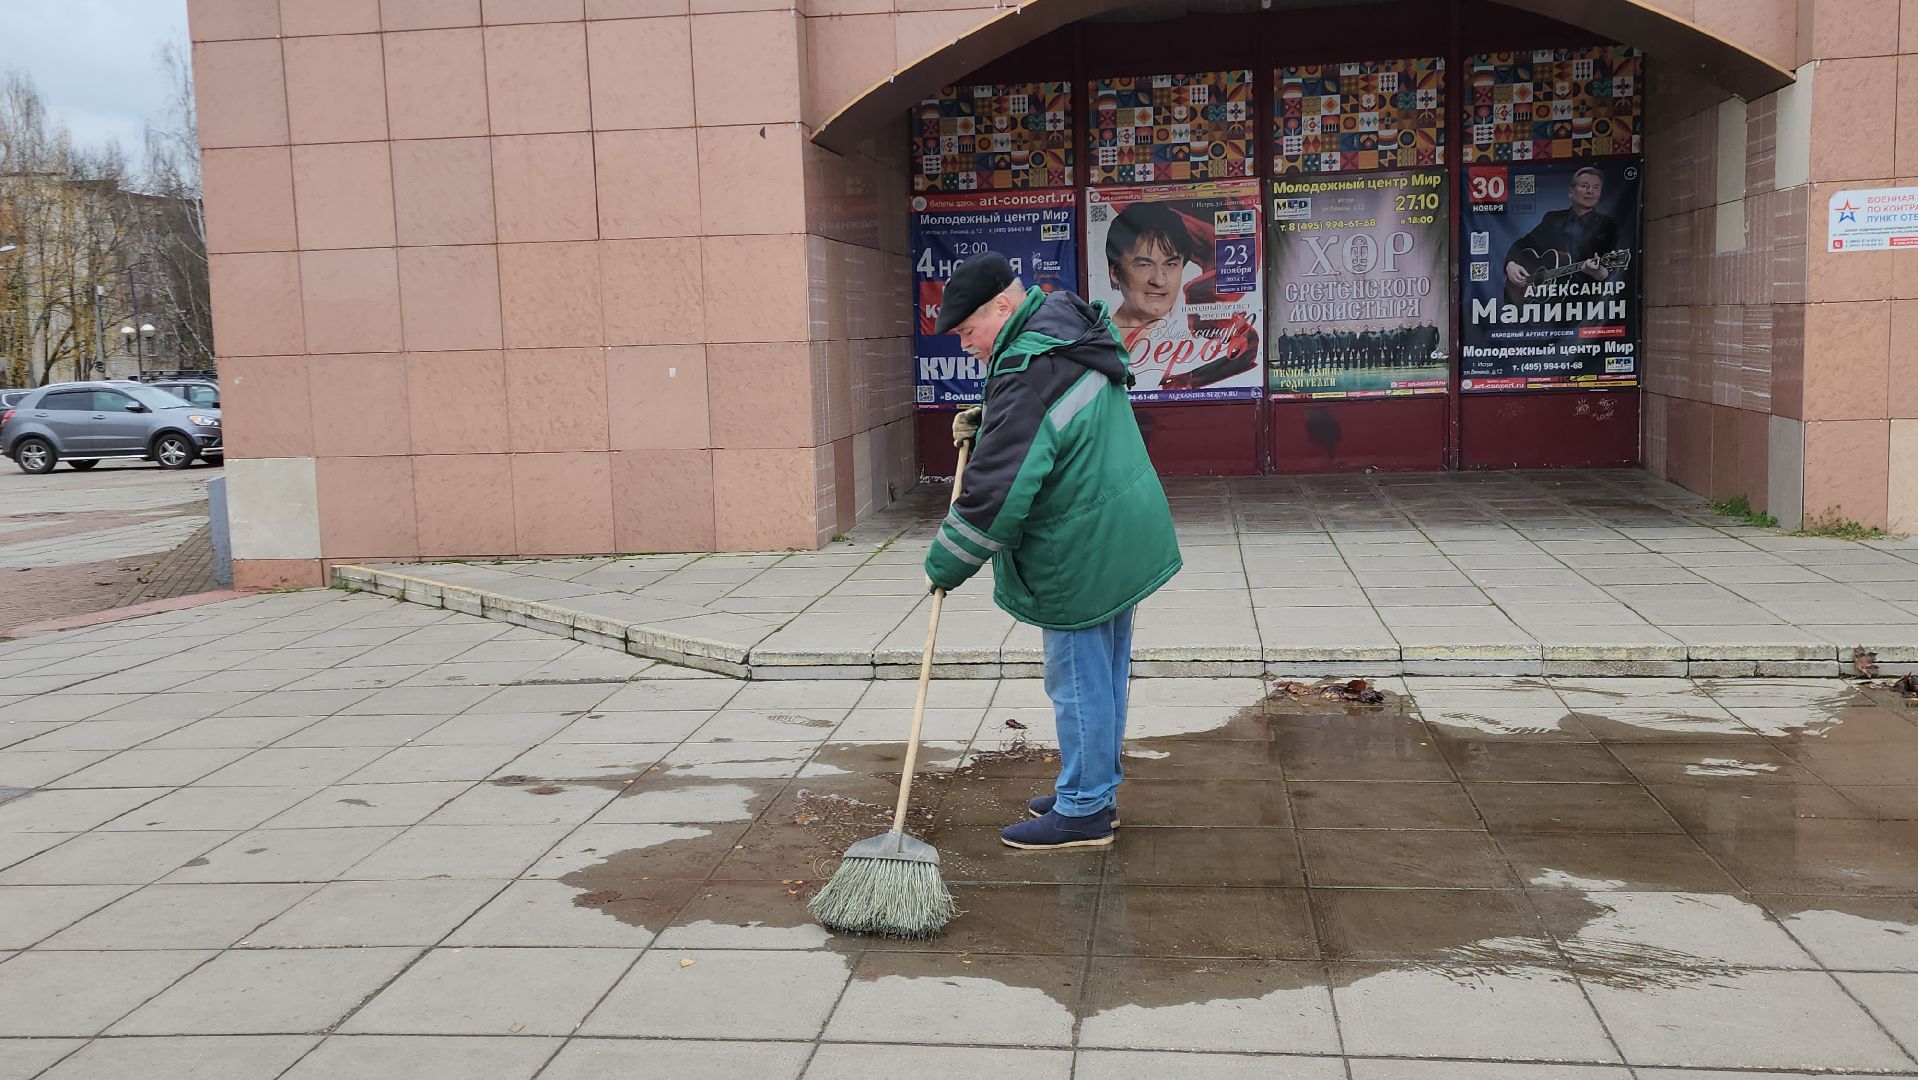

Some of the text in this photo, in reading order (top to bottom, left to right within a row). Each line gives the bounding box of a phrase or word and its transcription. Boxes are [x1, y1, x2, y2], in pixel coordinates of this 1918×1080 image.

[1273, 178, 1365, 194] Молодежный
[1368, 177, 1408, 190] центр
[1411, 173, 1441, 187] Мир
[1472, 176, 1505, 199] 30
[979, 192, 1075, 207] art-concert.ru
[1394, 193, 1439, 211] 27.10
[1867, 194, 1915, 204] ВОЕННАЯ
[1473, 204, 1504, 212] НОЯБРЯ
[920, 209, 1069, 226] Молодежный центр Мир
[1288, 222, 1296, 232] 8
[1297, 221, 1323, 233] (495)
[1325, 218, 1376, 229] 994-61-68
[1867, 214, 1898, 223] ПУНКТ
[953, 241, 988, 255] 12:00
[1224, 244, 1249, 266] 23
[1301, 231, 1415, 277] ХОР
[916, 247, 936, 278] 4
[1220, 265, 1252, 275] ноября
[1285, 277, 1431, 302] СРЕТЕНСКОГО
[1524, 281, 1626, 298] АЛЕКСАНДР
[1288, 298, 1421, 323] МОНАСТЫРЯ
[1472, 298, 1627, 325] Малинин
[1149, 319, 1239, 345] Александр
[1491, 329, 1575, 339] НАРОДНЫЙ АРТИСТ РОССИИ
[1463, 341, 1634, 359] Молодежный центр Мир
[1512, 362, 1583, 372] т. (495) 994-61-68
